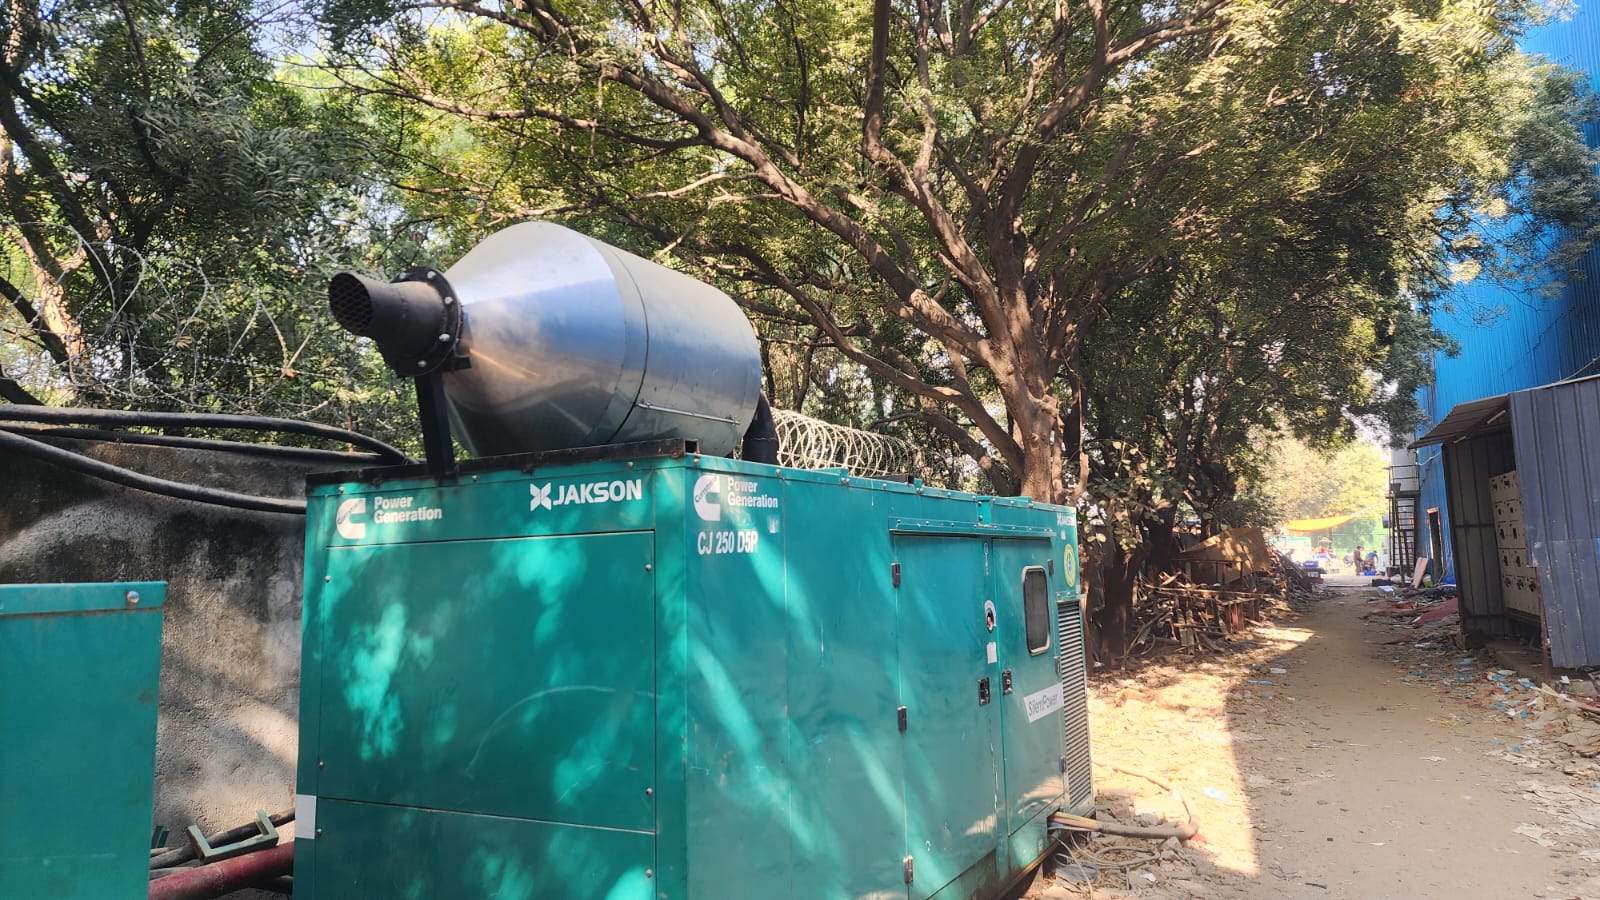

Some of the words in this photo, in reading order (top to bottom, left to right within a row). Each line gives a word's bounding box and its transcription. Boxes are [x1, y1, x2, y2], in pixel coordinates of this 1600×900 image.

[552, 479, 643, 506] JAKSON
[727, 476, 759, 493] Power
[374, 496, 414, 510] Power
[727, 491, 779, 508] Generation
[374, 506, 443, 524] Generation
[697, 531, 714, 555] CJ
[715, 531, 735, 554] 250
